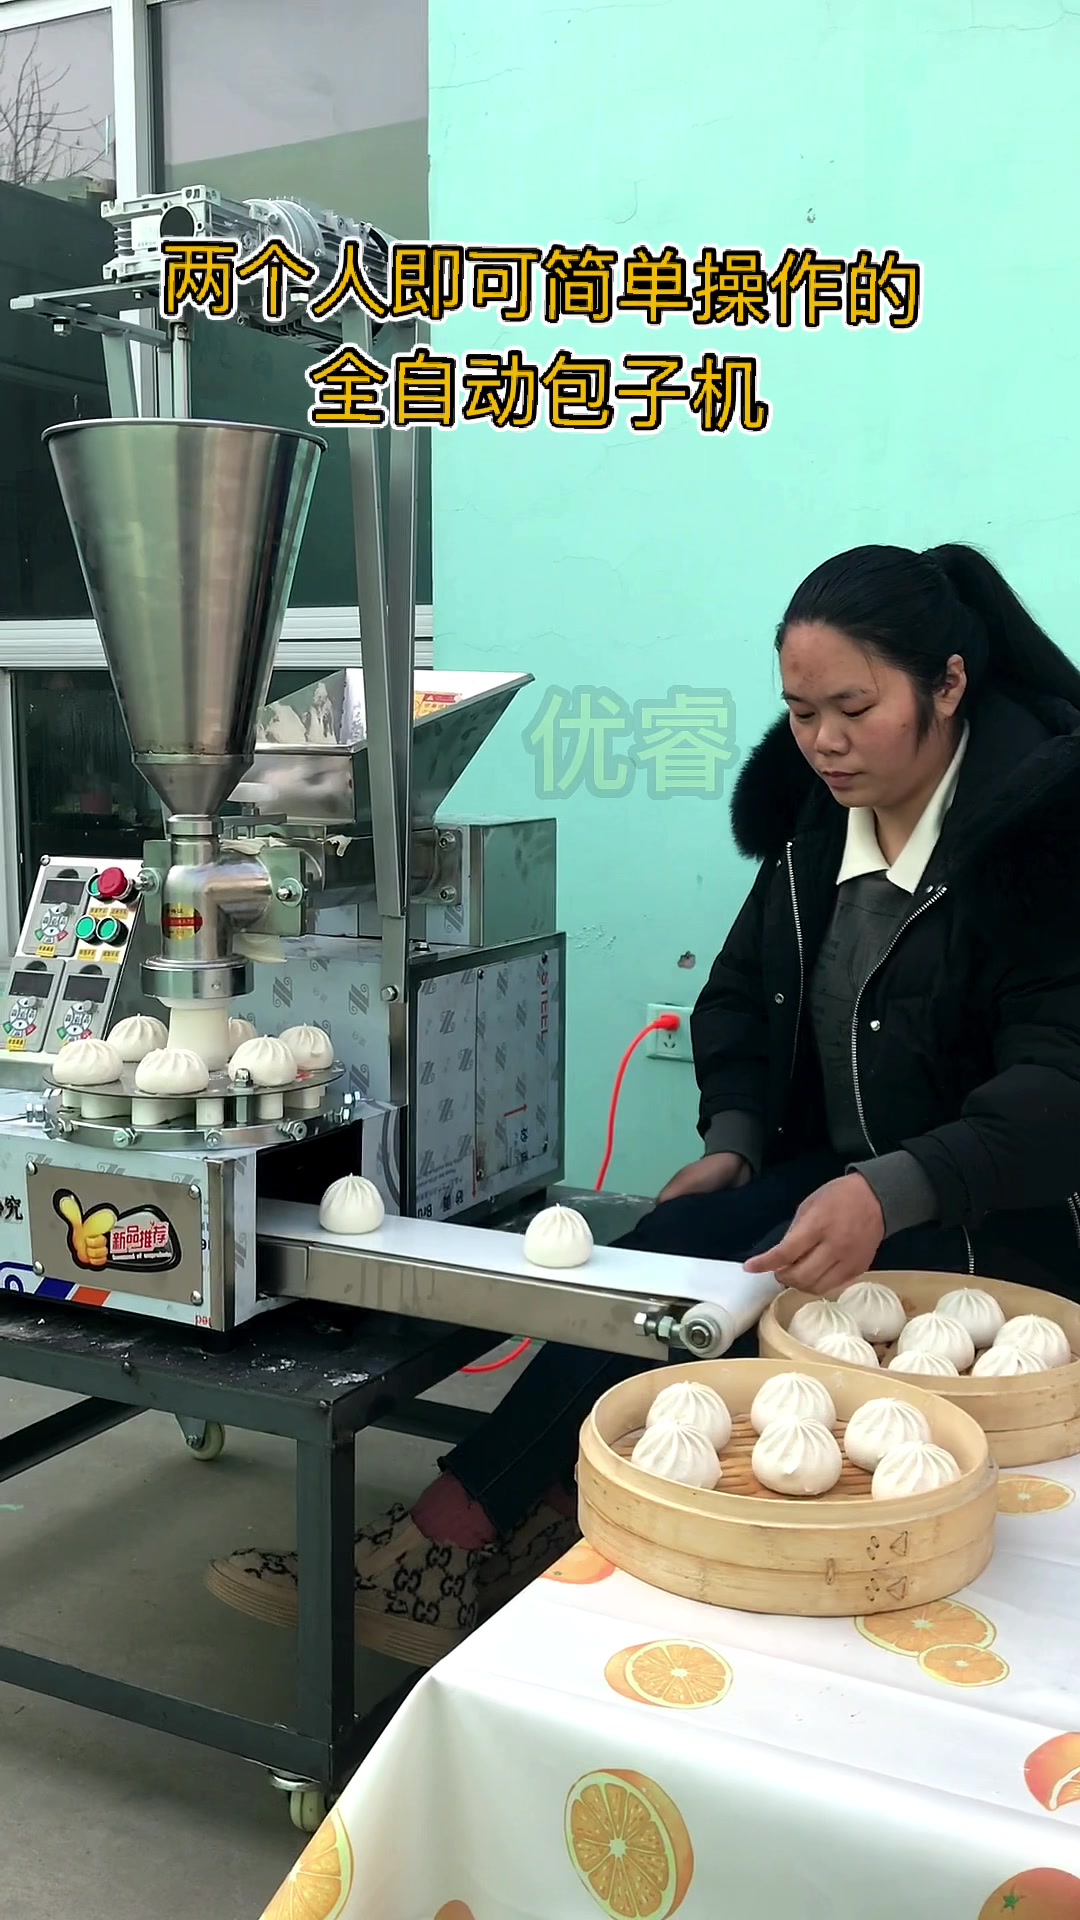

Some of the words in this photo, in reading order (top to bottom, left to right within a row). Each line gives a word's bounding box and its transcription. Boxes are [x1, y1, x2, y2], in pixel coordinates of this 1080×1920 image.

[0, 1195, 24, 1221] 究
[112, 1222, 168, 1250] 新品推荐
